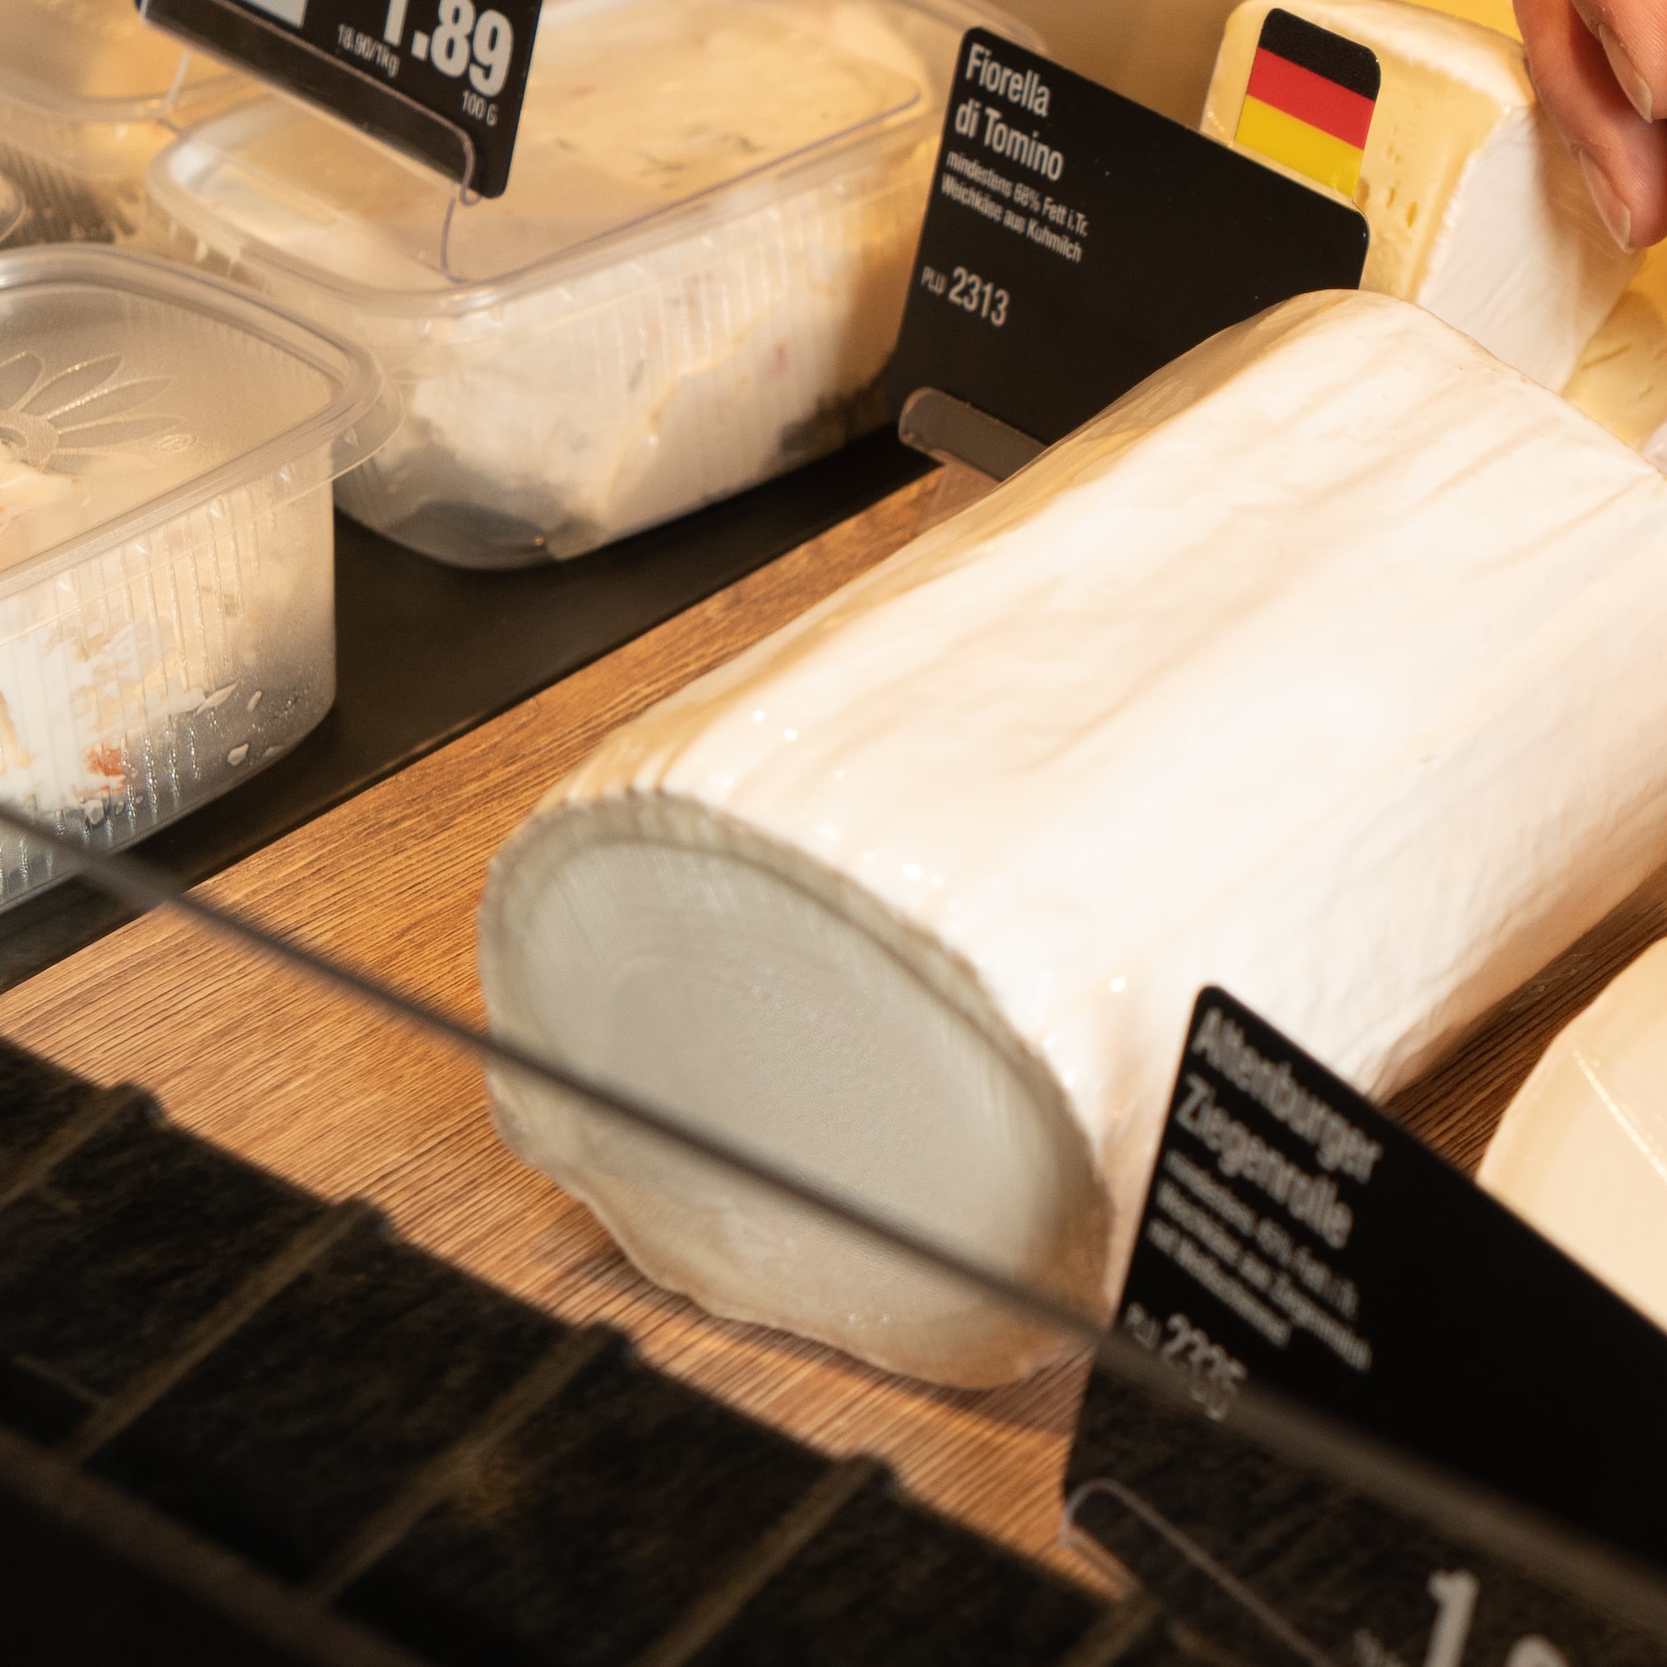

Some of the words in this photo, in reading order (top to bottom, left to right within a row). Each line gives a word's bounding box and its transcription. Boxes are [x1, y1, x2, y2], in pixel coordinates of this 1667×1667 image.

[337, 23, 400, 79] 18.90/1kg
[965, 41, 1051, 118] Fiorella
[462, 89, 487, 120] 100
[486, 103, 498, 127] G
[954, 98, 981, 139] di
[983, 106, 1065, 182] Tomino
[941, 172, 1004, 223] Weichkäse
[1003, 207, 1027, 234] aus
[1026, 217, 1084, 265] Kuhmilch
[946, 150, 1013, 199] mindestens
[1042, 195, 1068, 227] Fett
[921, 265, 948, 297] PLU
[949, 265, 1010, 328] 2313
[1191, 1006, 1385, 1187] Altenburger
[1174, 1071, 1354, 1252] Ziegenrolle
